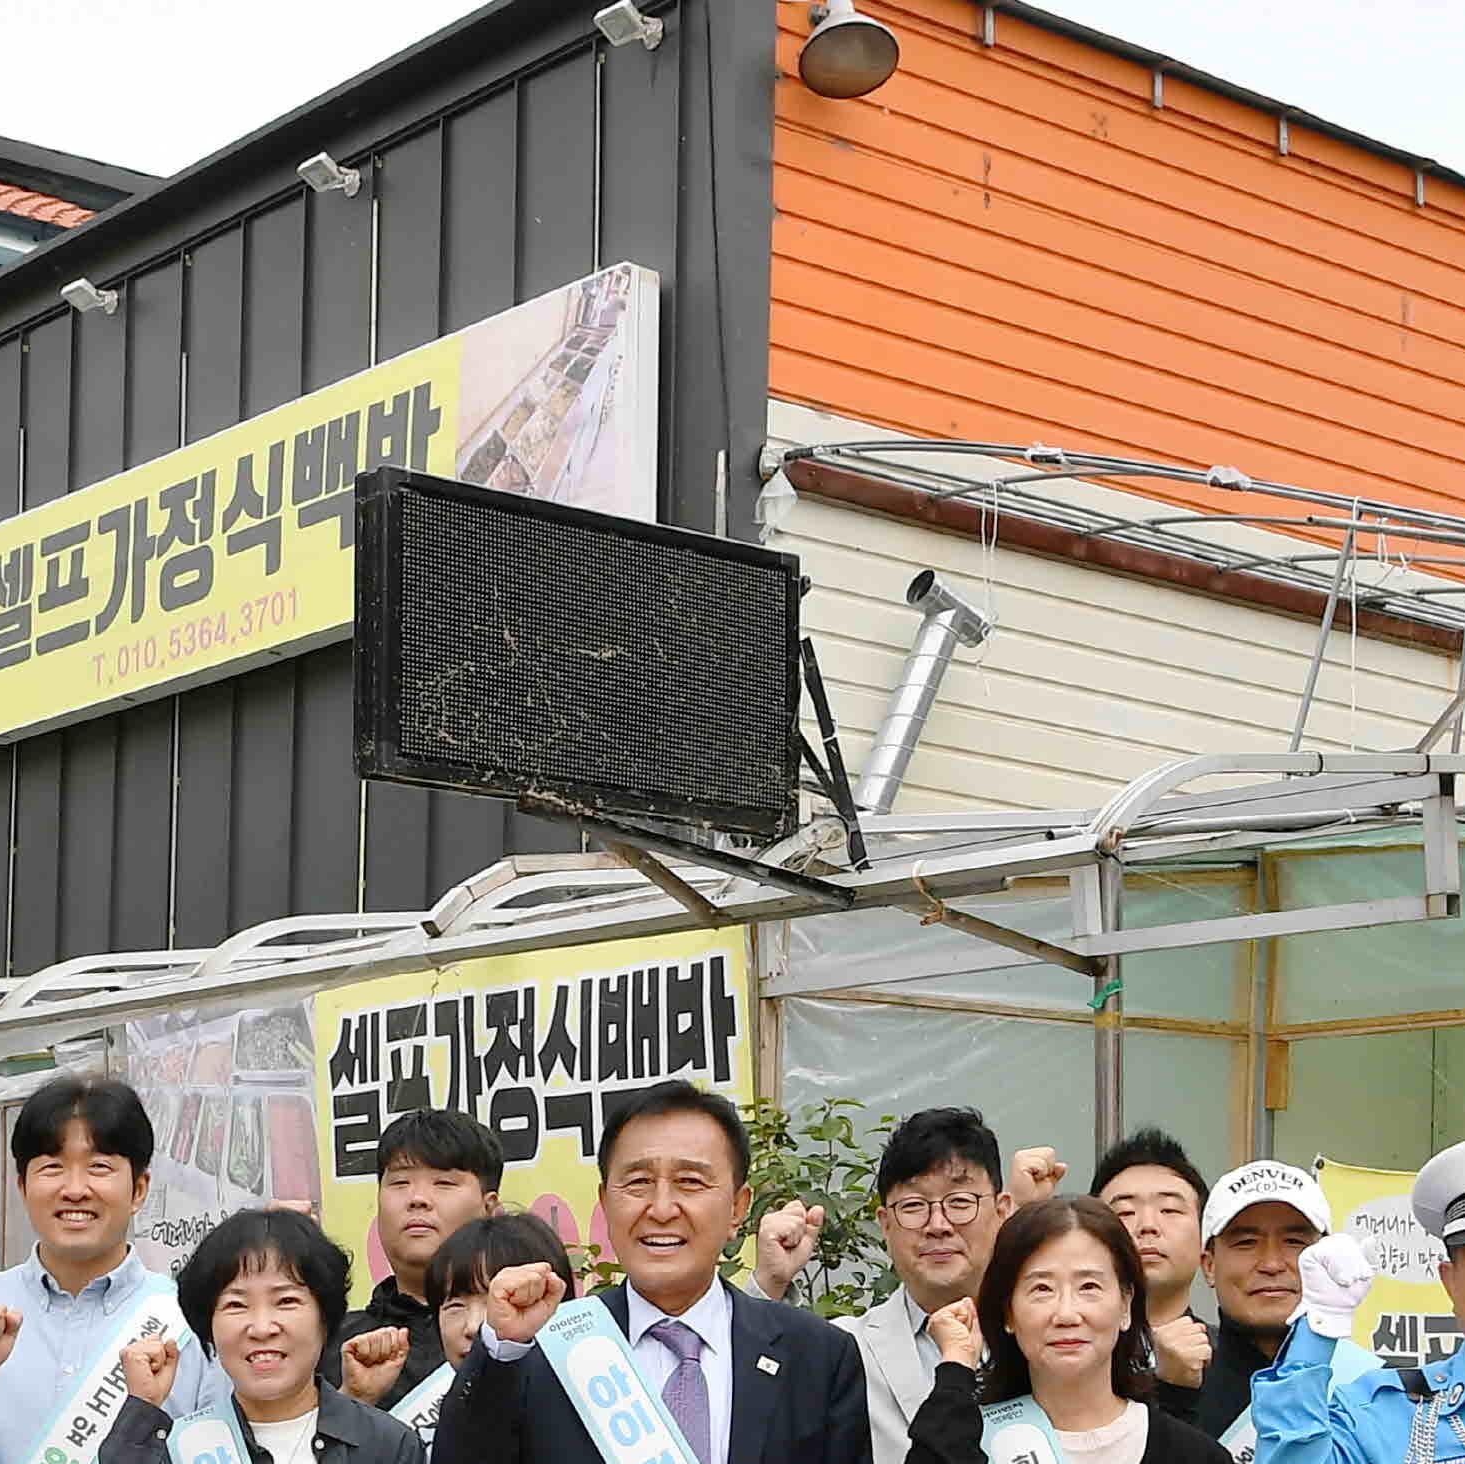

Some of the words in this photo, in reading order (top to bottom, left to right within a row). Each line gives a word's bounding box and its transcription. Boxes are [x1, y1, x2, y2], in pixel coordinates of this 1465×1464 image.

[1228, 1168, 1304, 1194] DENVER
[1355, 1213, 1416, 1236] 어머니가
[1379, 1242, 1410, 1275] 향의
[588, 1363, 656, 1447] 아이
[66, 1416, 98, 1448] 앞
